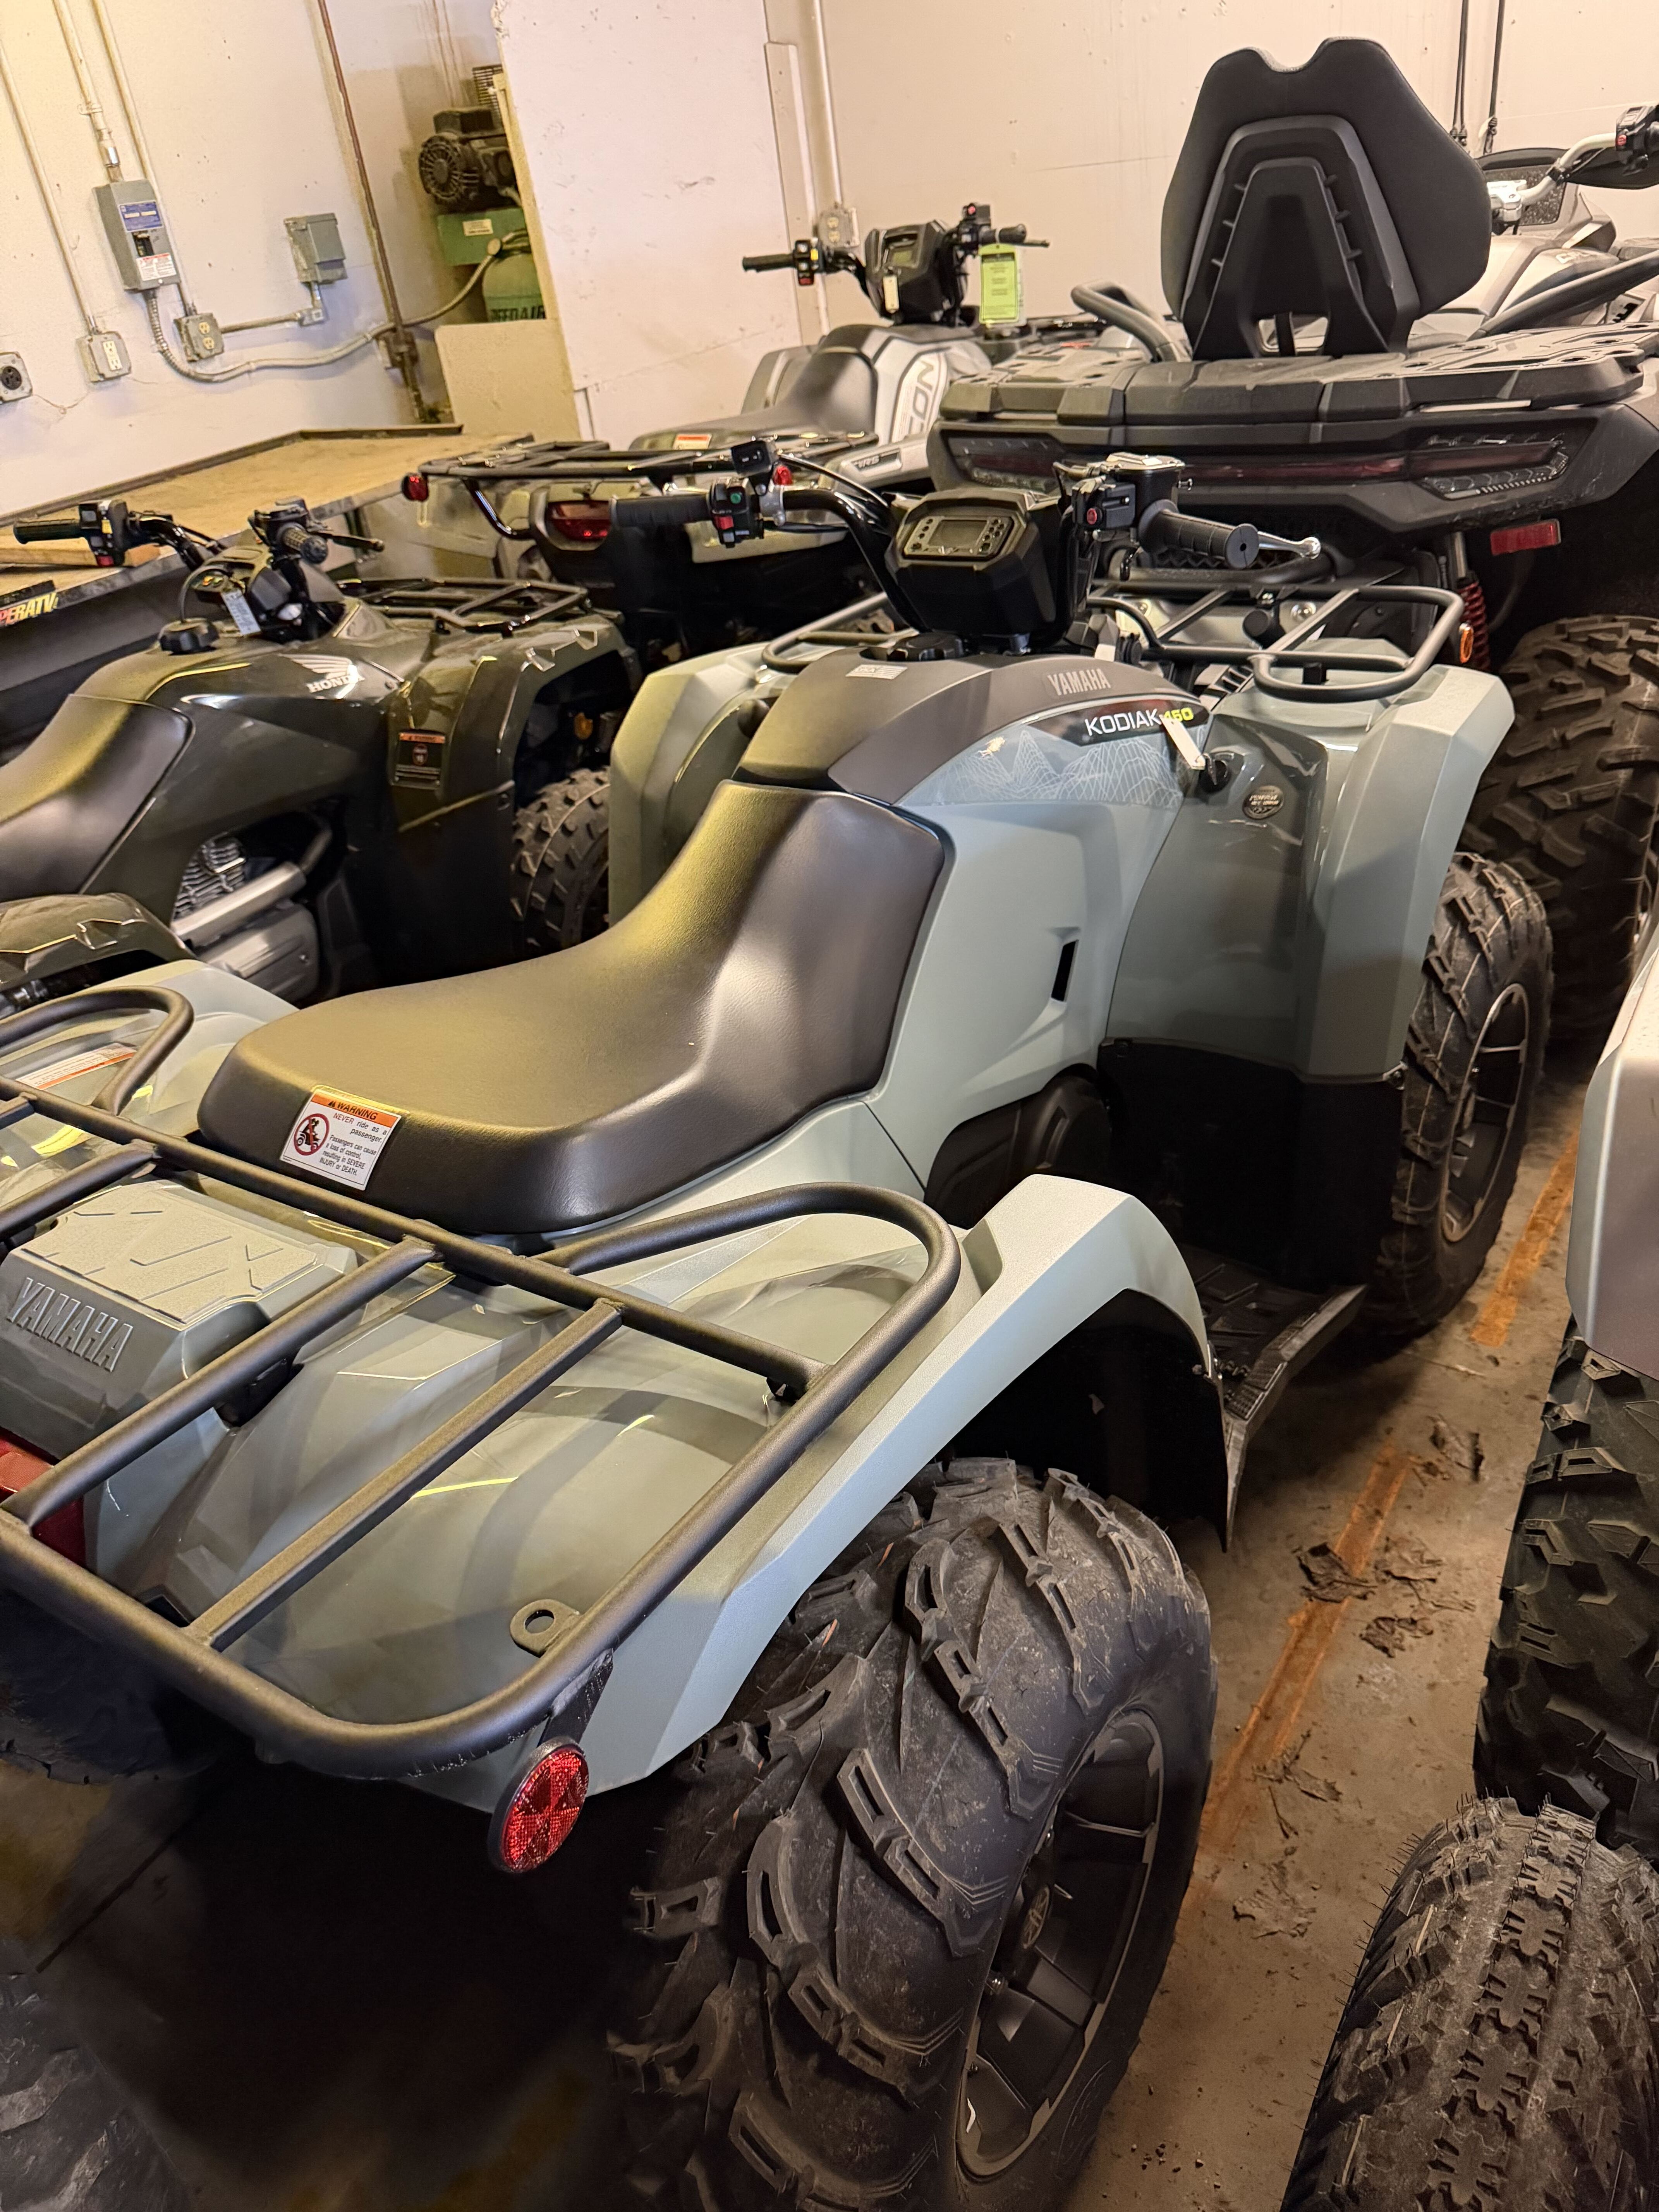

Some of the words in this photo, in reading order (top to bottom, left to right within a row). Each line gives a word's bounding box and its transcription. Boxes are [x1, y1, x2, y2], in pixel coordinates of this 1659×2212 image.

[1048, 668, 1111, 696] YAMAHA
[1085, 708, 1162, 736] KODIAK
[338, 1102, 378, 1120] WARNING
[333, 1113, 354, 1124] NEVER
[357, 1121, 369, 1129] ride
[350, 1128, 382, 1142] passenger.
[330, 1135, 354, 1147] Passengers
[363, 1147, 377, 1156] cause
[319, 1157, 335, 1168] INJURY
[323, 1151, 341, 1162] resulting
[347, 1158, 366, 1169] SEVERE
[7, 1277, 133, 1372] YAMAHA
